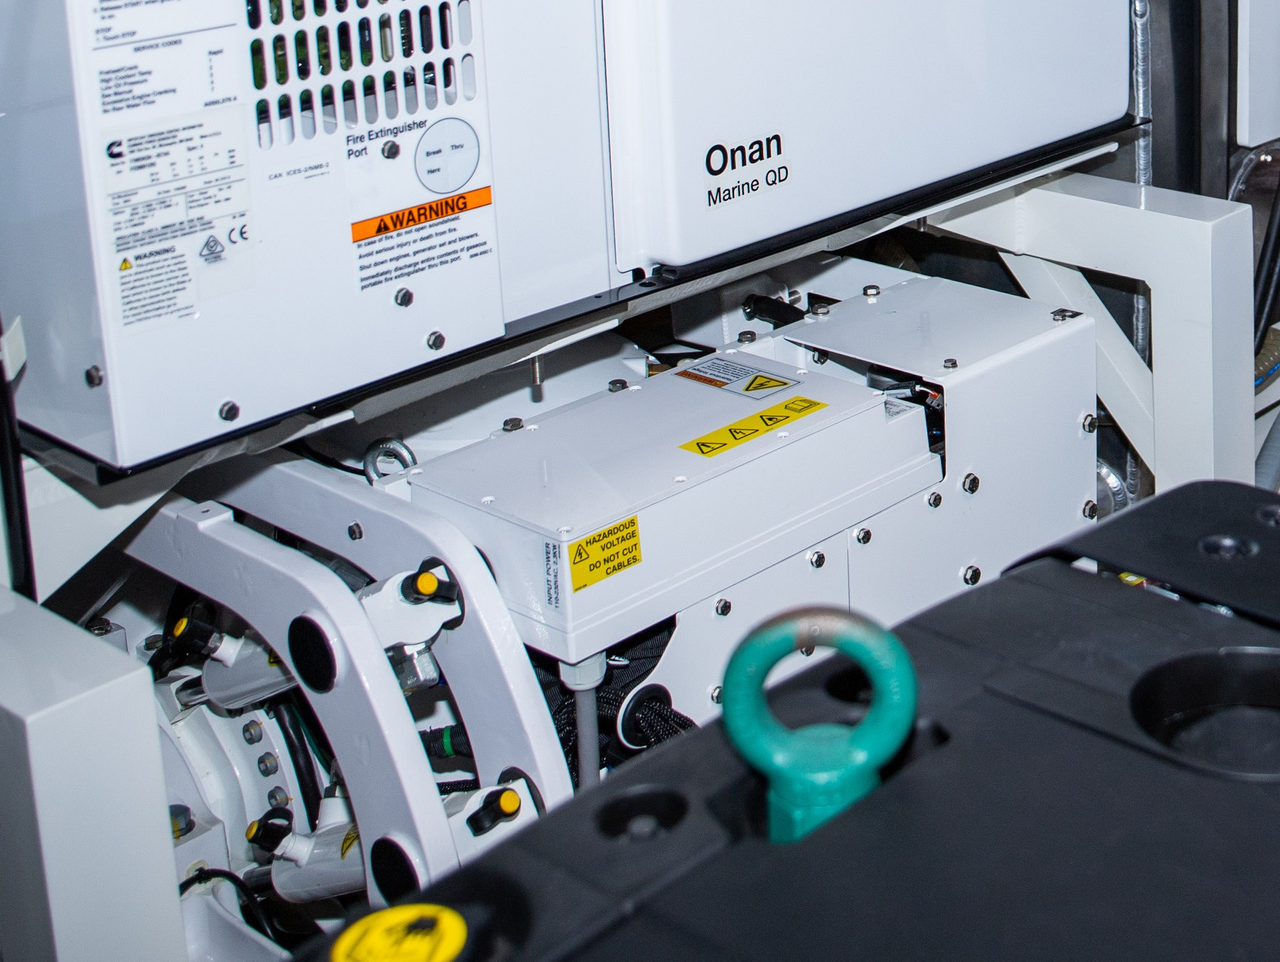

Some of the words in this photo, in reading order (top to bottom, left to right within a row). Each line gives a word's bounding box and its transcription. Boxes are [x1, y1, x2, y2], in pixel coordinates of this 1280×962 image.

[346, 135, 366, 146] Fire
[368, 119, 428, 141] Extinguisher
[347, 146, 368, 159] Port
[426, 148, 442, 157] Break
[450, 143, 464, 151] Thru
[705, 133, 782, 177] Onan
[427, 167, 441, 175] Here
[707, 179, 760, 207] Marine
[765, 165, 789, 187] QD
[390, 195, 467, 229] WARNING
[384, 234, 395, 242] fire,
[404, 228, 413, 236] not
[414, 225, 427, 234] open
[428, 215, 461, 229] soundshield.
[358, 251, 374, 259] Avoid
[375, 245, 395, 254] serious
[396, 240, 411, 250] injury
[419, 233, 434, 242] death
[435, 229, 447, 238] from
[359, 263, 373, 271] Shut
[373, 259, 388, 267] down
[389, 252, 412, 264] engines,
[412, 245, 437, 257] generator
[447, 238, 457, 246] and
[458, 232, 480, 242] blowers.
[360, 269, 392, 282] Immediately
[394, 260, 420, 273] discharge
[420, 255, 436, 265] entire
[436, 249, 459, 260] contents
[466, 240, 487, 251] gaseous
[361, 279, 383, 291] portable
[384, 274, 393, 283] fire
[394, 266, 427, 280] extinguisher
[427, 262, 438, 270] thru
[450, 255, 462, 264] port.
[585, 519, 636, 547] HAZARDOUS
[601, 530, 637, 552] VOLTAGE
[589, 560, 601, 572] DO
[603, 552, 620, 565] NOT
[622, 543, 638, 556] CUT
[605, 555, 640, 575] CABLES.
